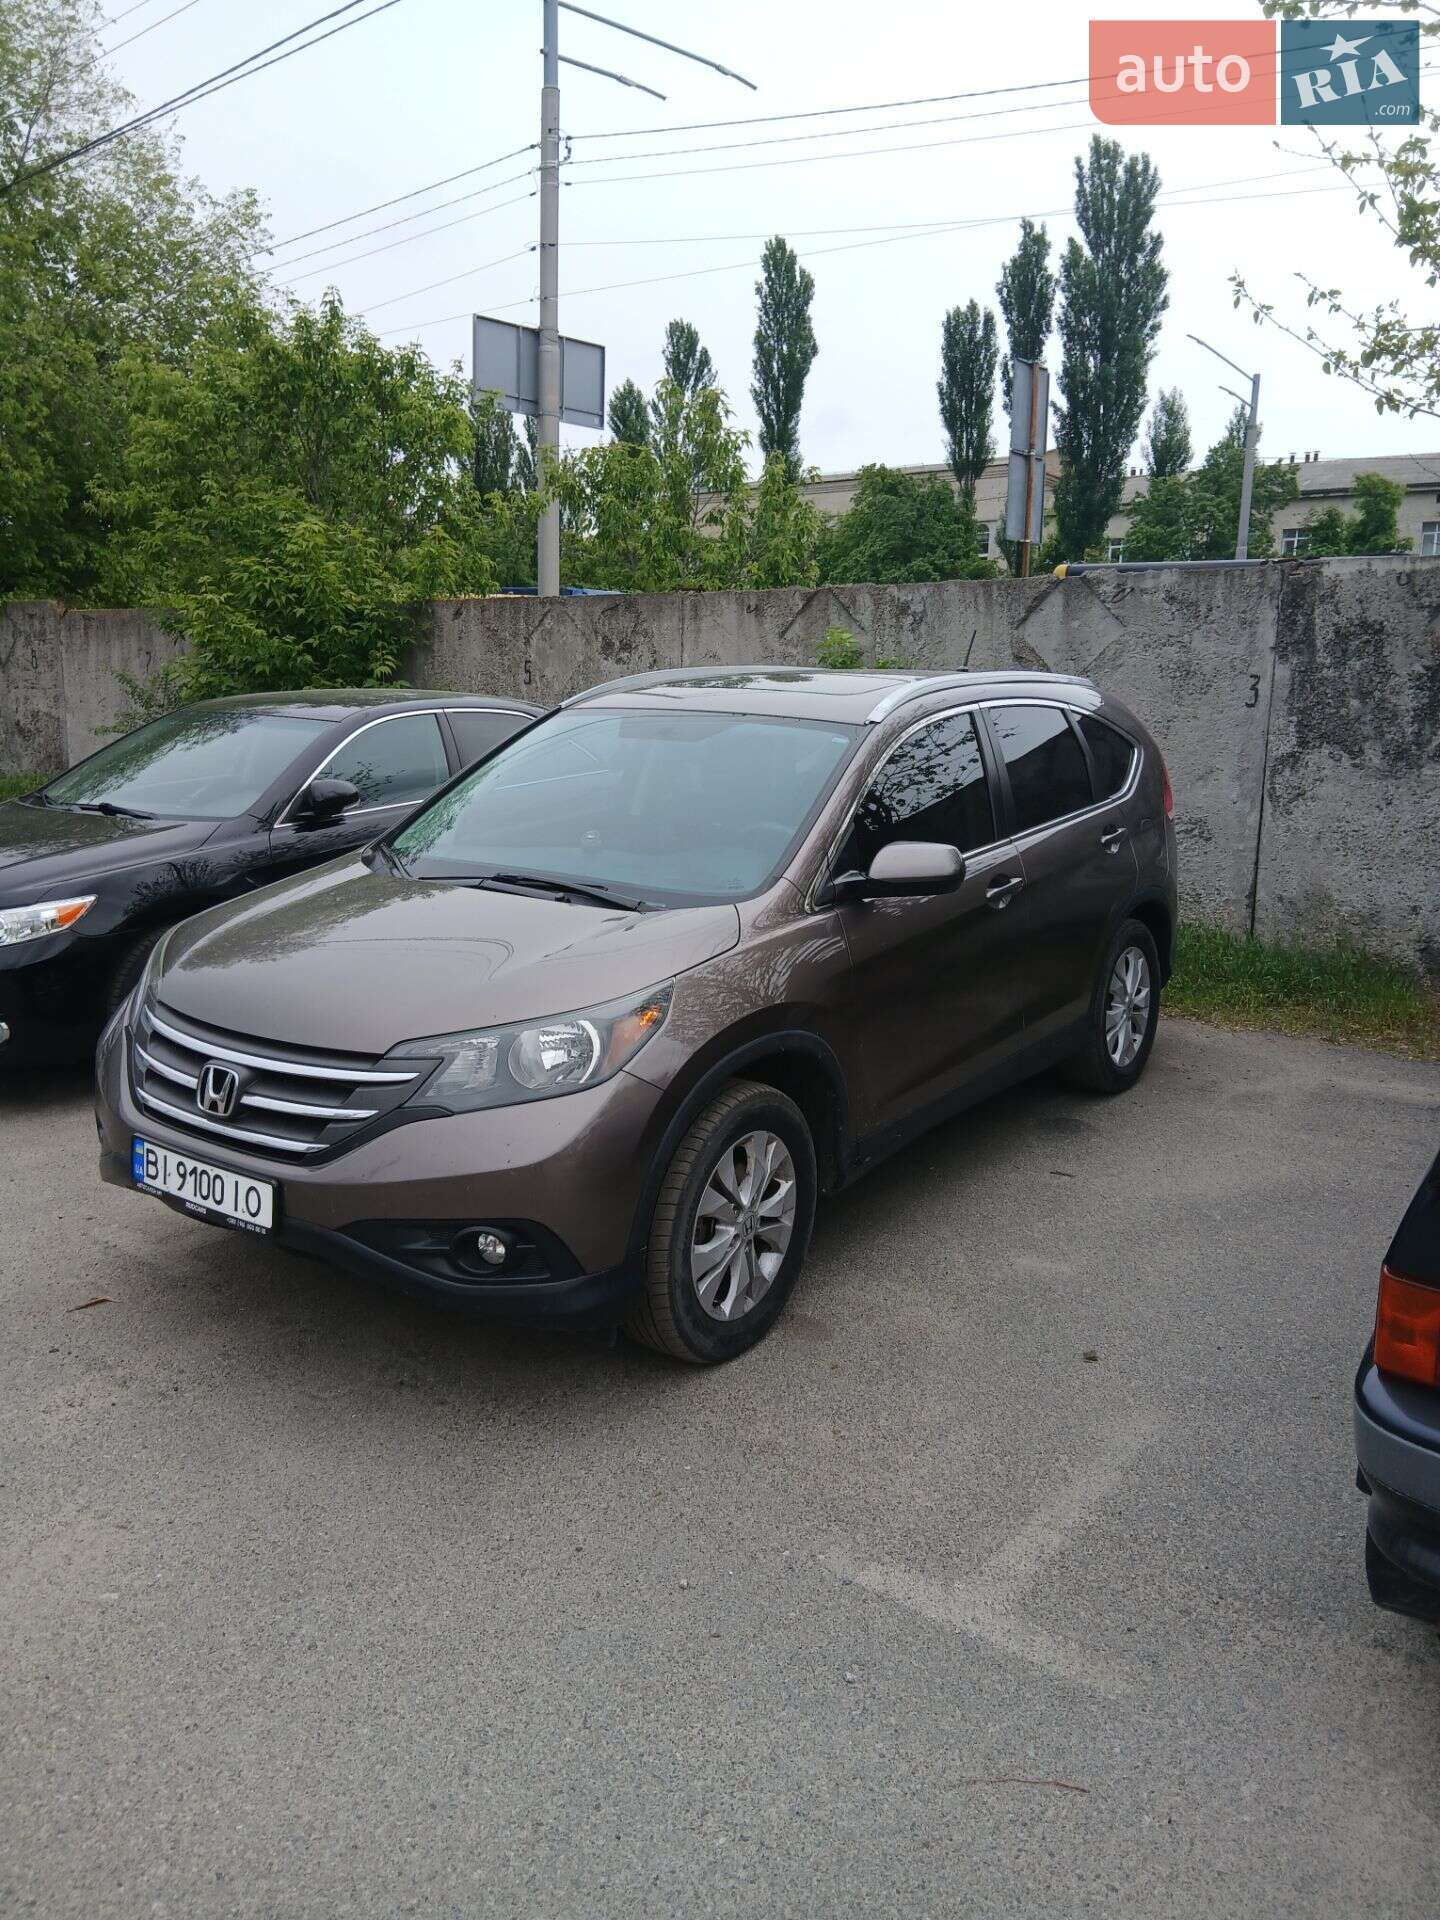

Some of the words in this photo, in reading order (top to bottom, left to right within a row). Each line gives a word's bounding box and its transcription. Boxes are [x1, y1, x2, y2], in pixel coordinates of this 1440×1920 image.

[524, 660, 531, 685] 5
[1245, 674, 1261, 708] 3
[145, 1148, 168, 1185] BI
[176, 1160, 225, 1206] 9100
